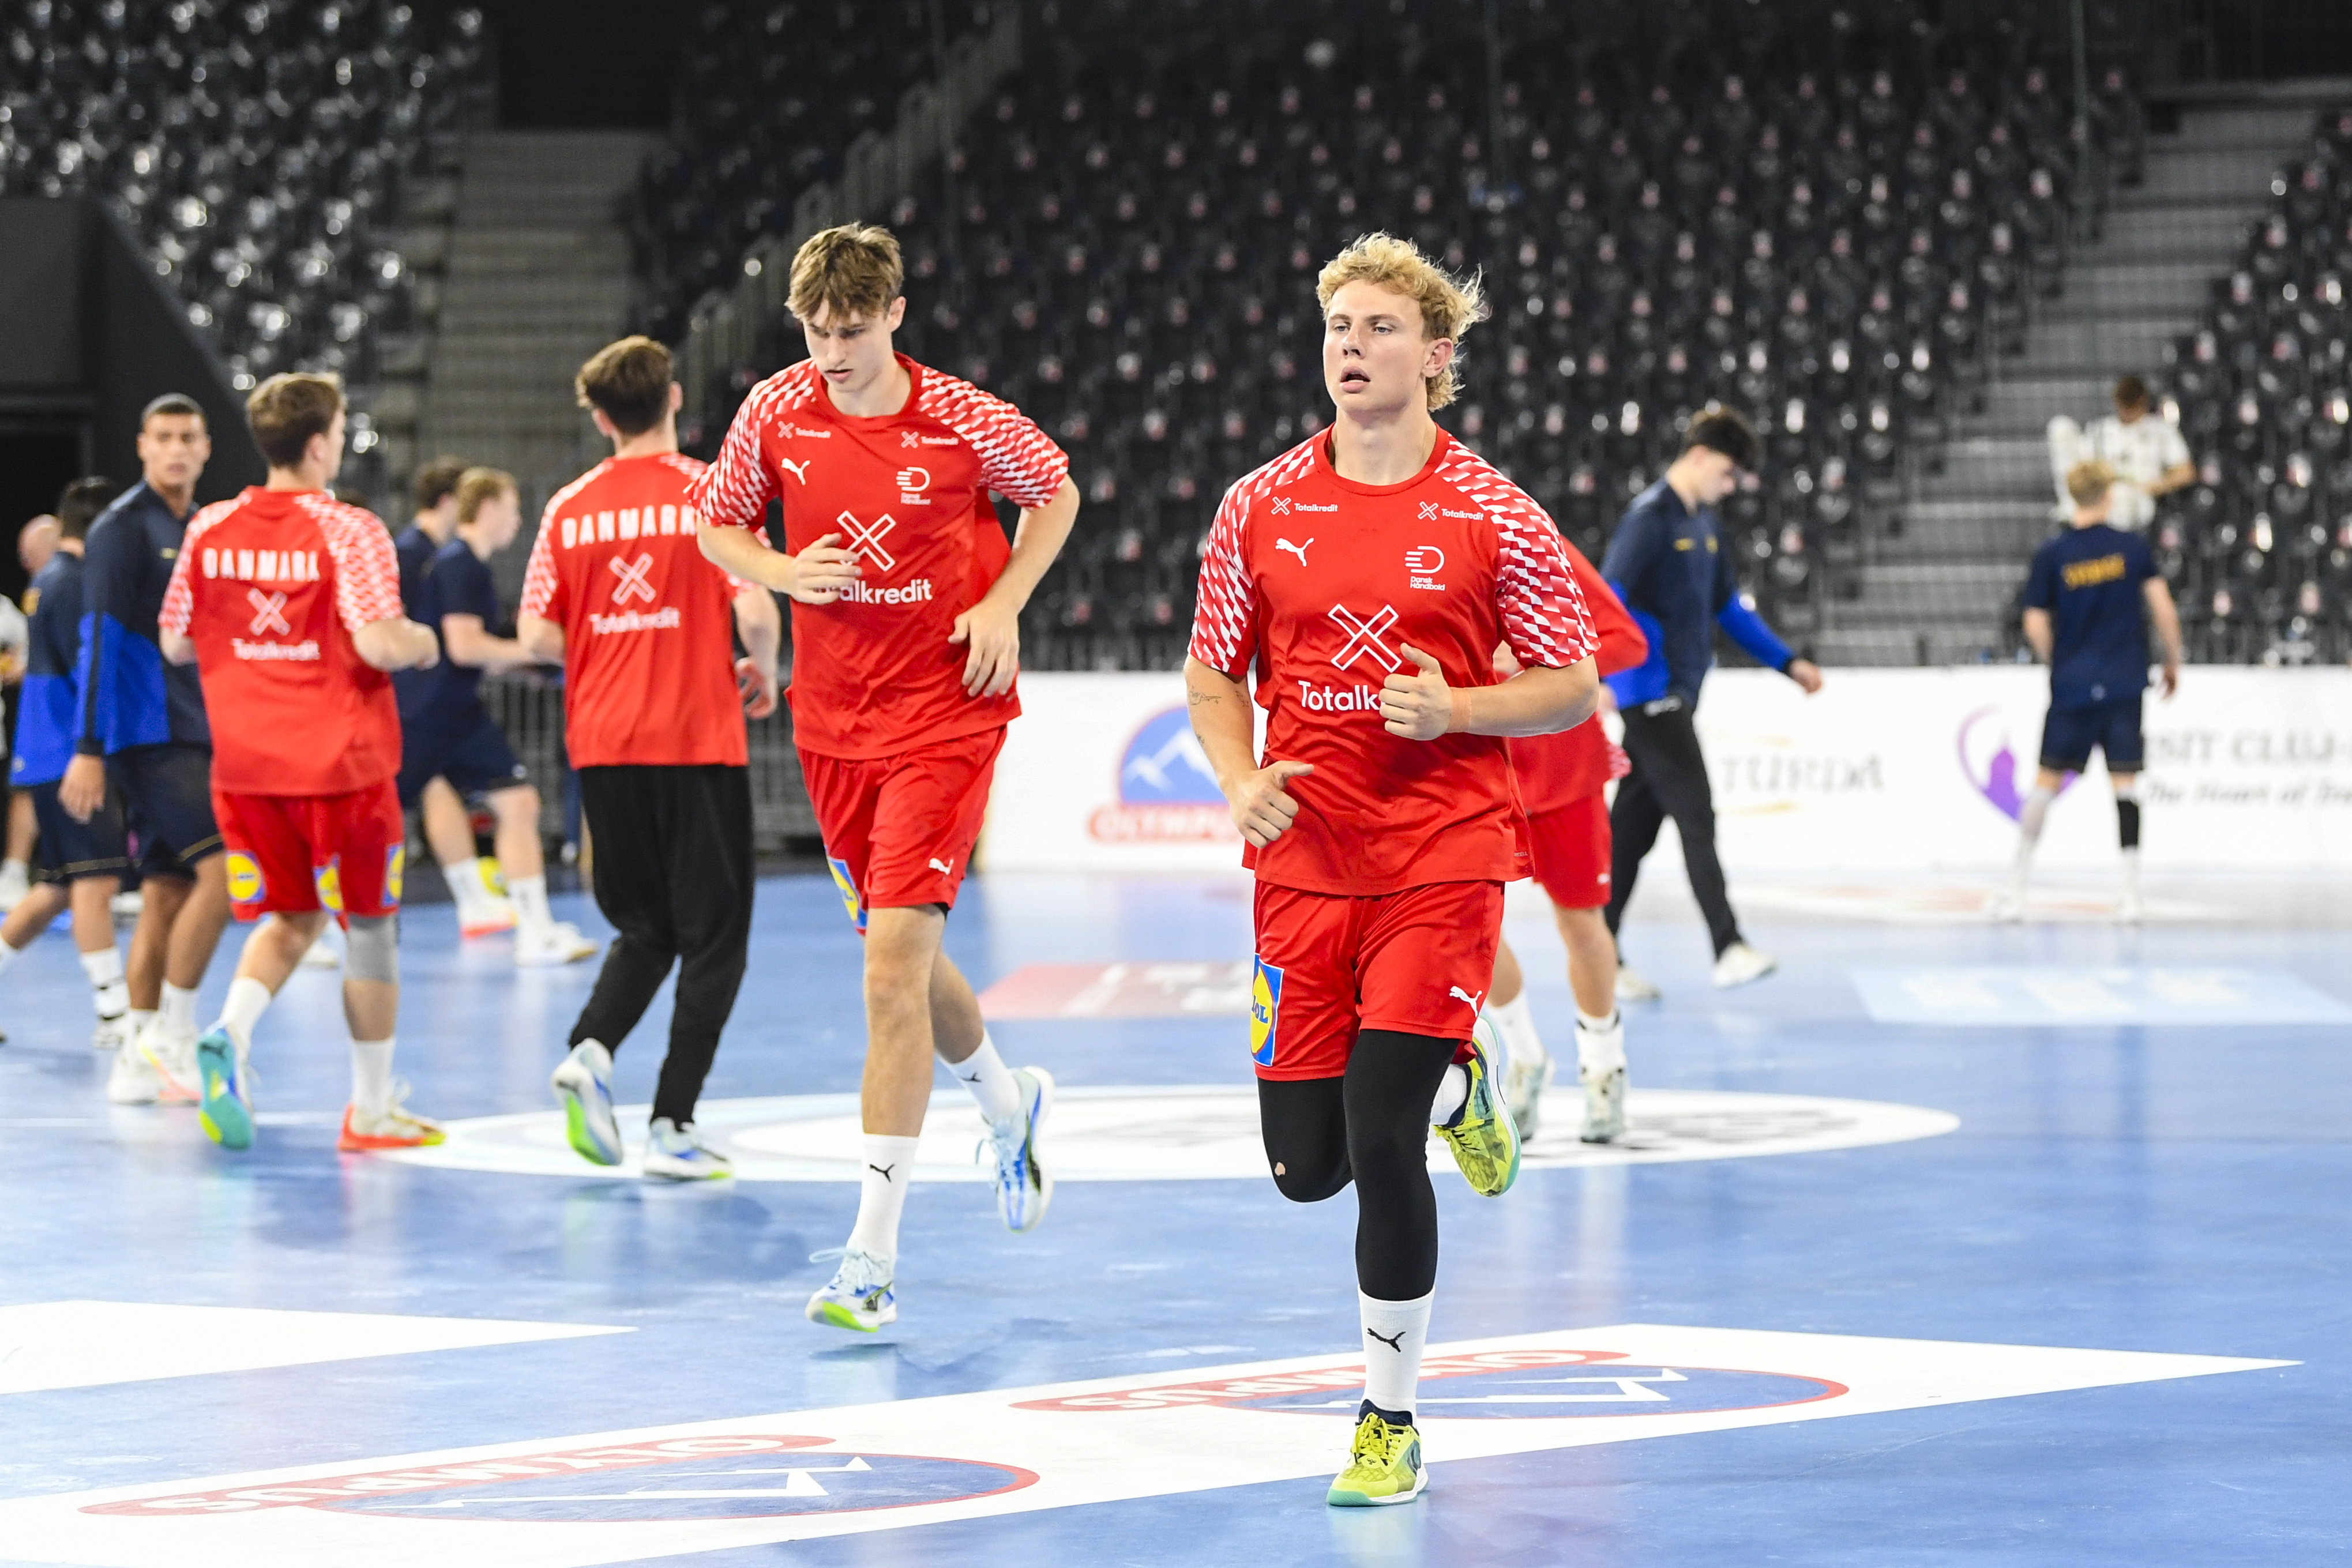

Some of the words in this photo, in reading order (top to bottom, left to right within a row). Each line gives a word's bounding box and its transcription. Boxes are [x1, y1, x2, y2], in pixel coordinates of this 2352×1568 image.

[795, 427, 831, 438] Totalkredit
[921, 436, 959, 445] Totalkredit
[1294, 502, 1338, 513] Totalkredit
[1441, 508, 1484, 521] Totalkredit
[561, 503, 696, 550] DANMARK
[813, 578, 933, 604] alkredit
[588, 606, 680, 636] Totalkredit
[231, 638, 321, 661] Totalkredit
[1298, 680, 1381, 711] Totalk
[141, 1438, 783, 1511] OLYMPUS
